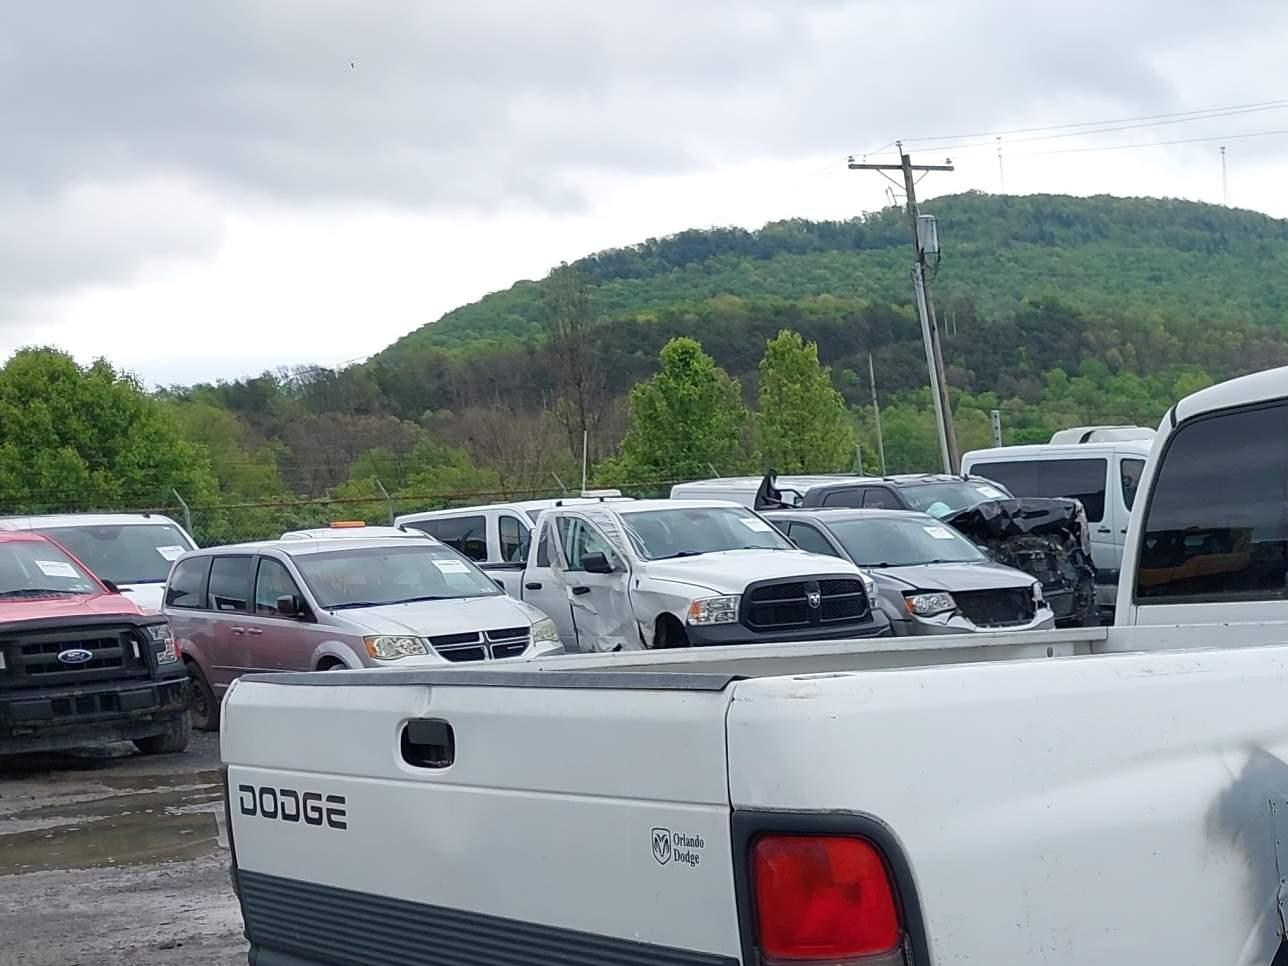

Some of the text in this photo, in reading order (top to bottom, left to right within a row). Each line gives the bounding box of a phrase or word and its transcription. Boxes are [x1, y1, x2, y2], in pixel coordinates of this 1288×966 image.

[239, 784, 347, 830] DODGE
[673, 832, 705, 849] Orlando
[673, 848, 700, 868] Dodge
